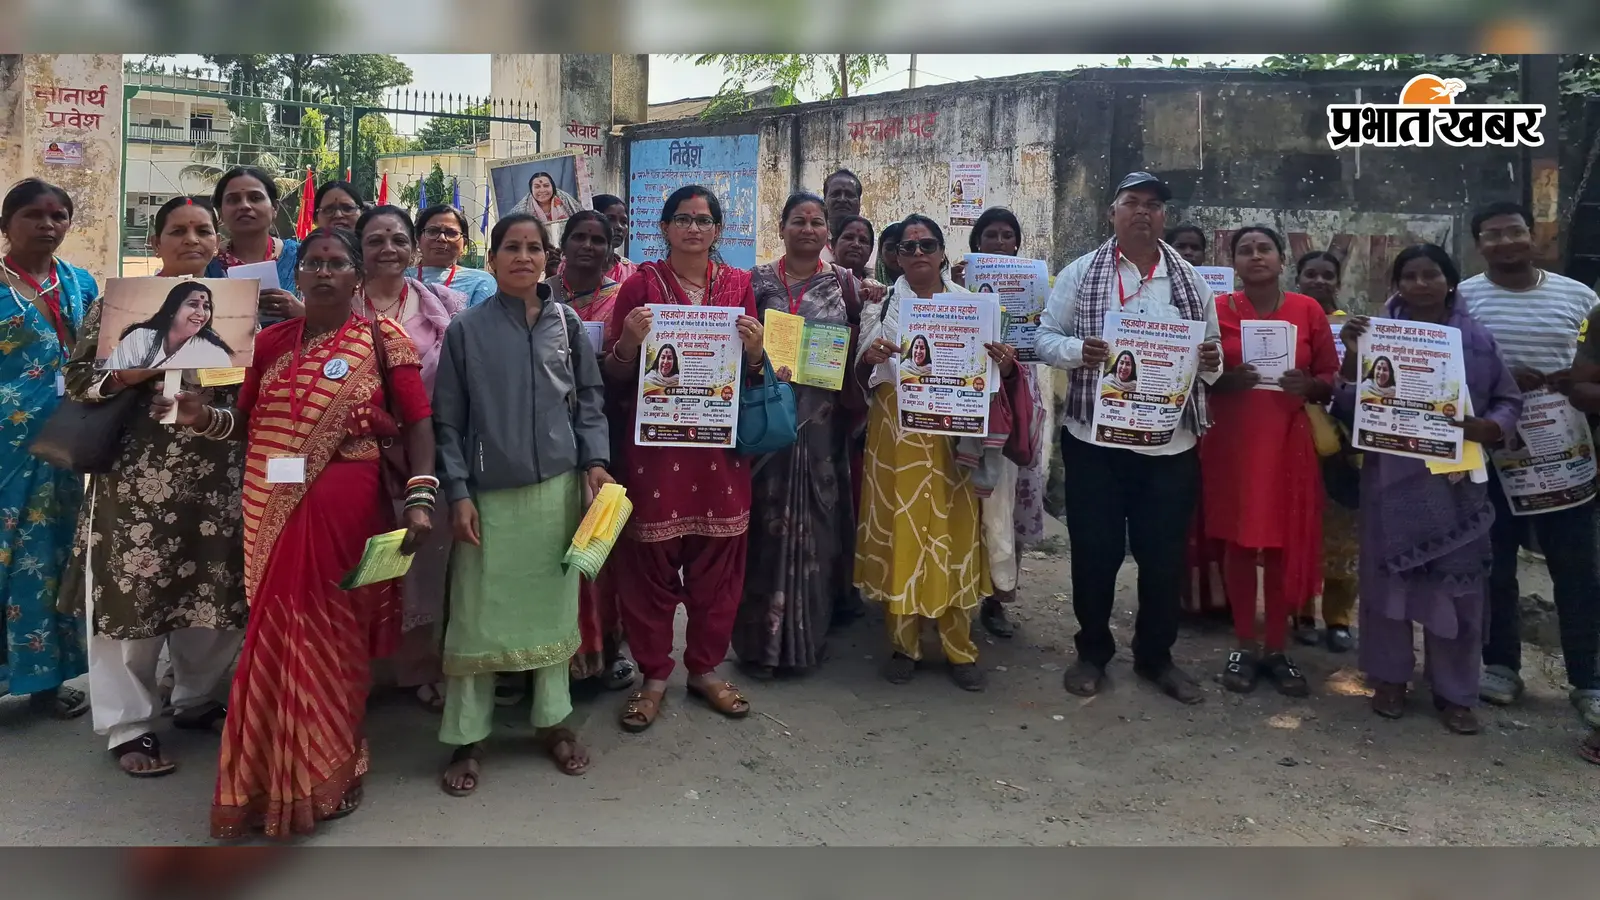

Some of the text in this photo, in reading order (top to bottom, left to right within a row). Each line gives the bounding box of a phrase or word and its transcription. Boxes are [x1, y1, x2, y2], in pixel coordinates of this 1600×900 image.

[44, 108, 104, 132] प्रवेश
[660, 309, 685, 320] सहजयोग
[709, 310, 728, 321] महायोग
[1121, 318, 1146, 328] सहजयोग
[1147, 321, 1159, 330] आज
[1169, 323, 1189, 333] महायोग
